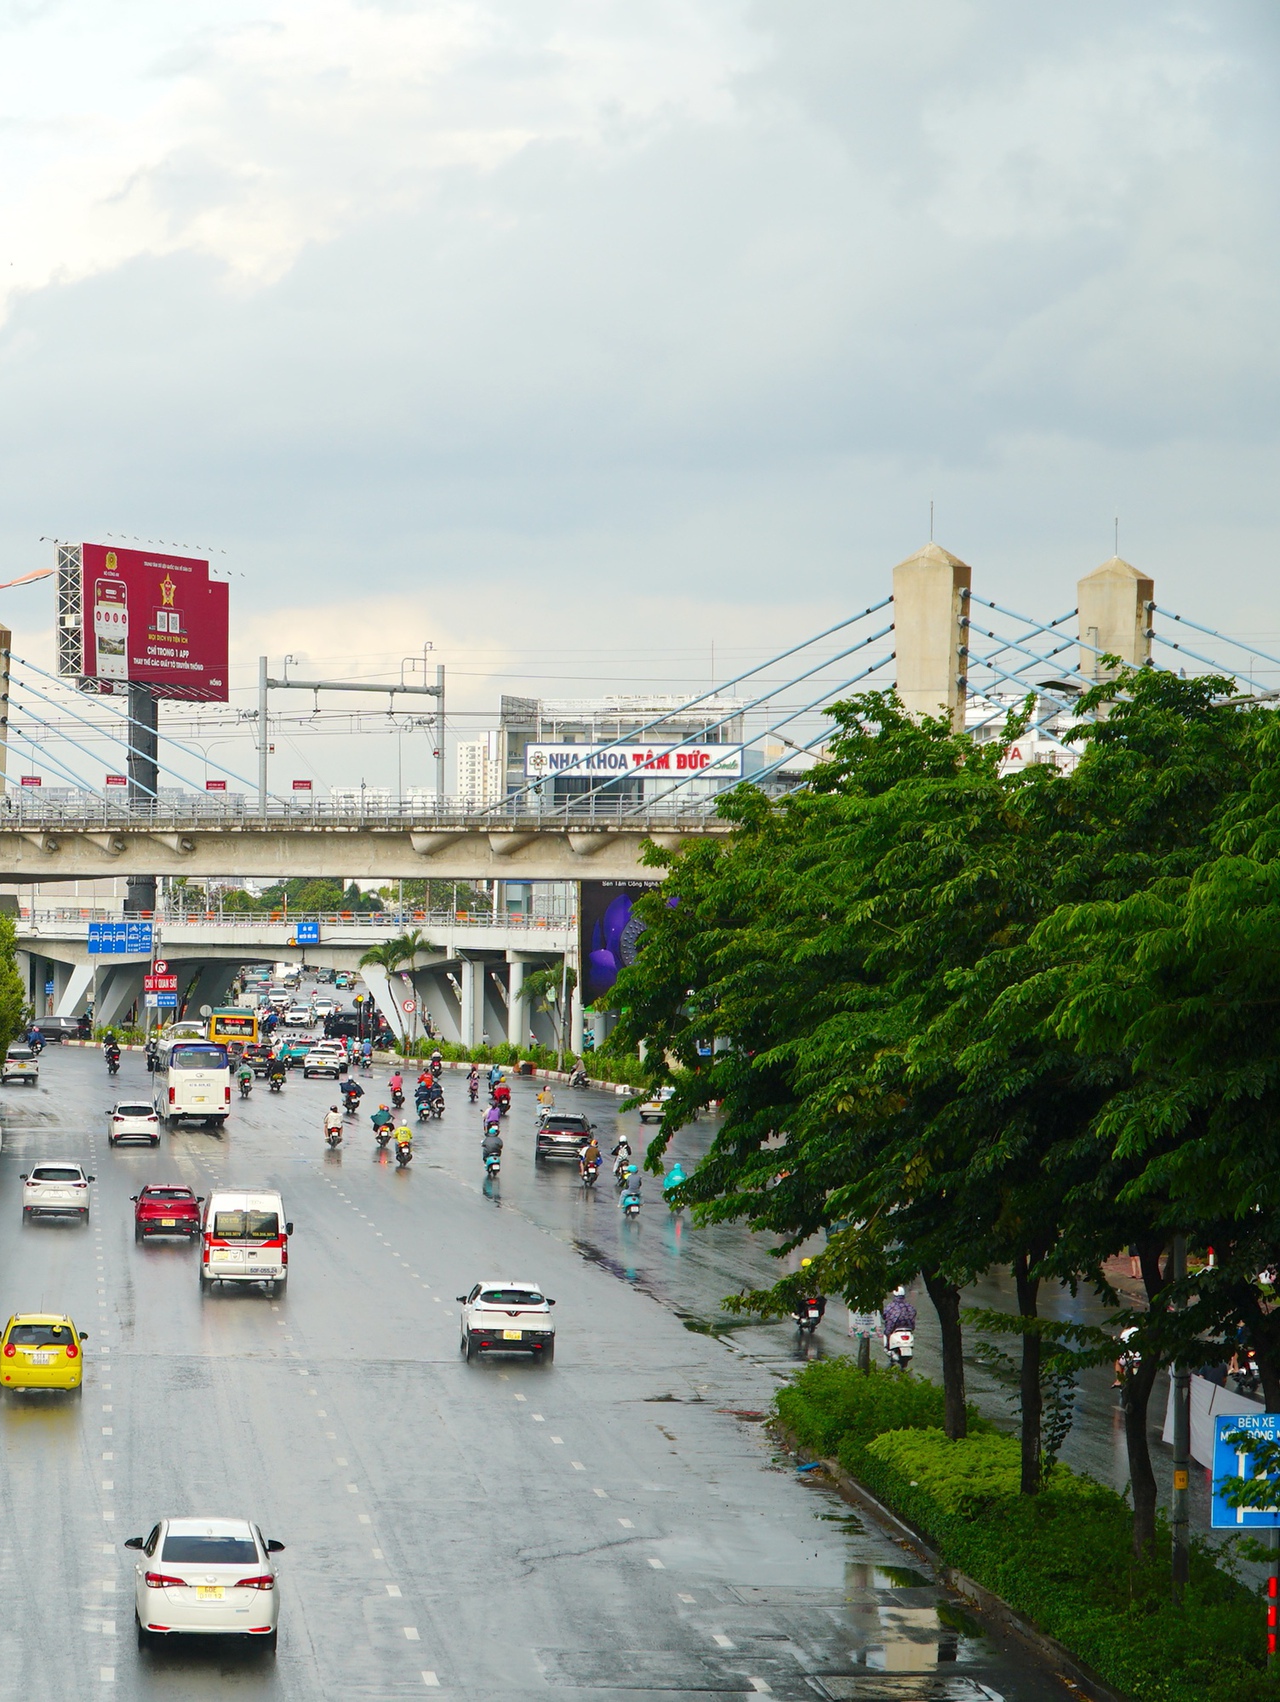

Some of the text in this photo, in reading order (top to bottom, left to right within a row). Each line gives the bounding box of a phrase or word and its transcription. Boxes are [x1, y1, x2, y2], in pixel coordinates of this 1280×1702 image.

[147, 645, 190, 658] CHỈ TRONG 1 APP
[549, 753, 581, 770] NHA
[586, 753, 628, 770] KHOA
[632, 750, 670, 770] TÂM
[676, 750, 710, 770] ĐỨC
[145, 977, 154, 989] CHÚ
[158, 978, 169, 989] QUAN
[1238, 1416, 1276, 1428] BẾN XE
